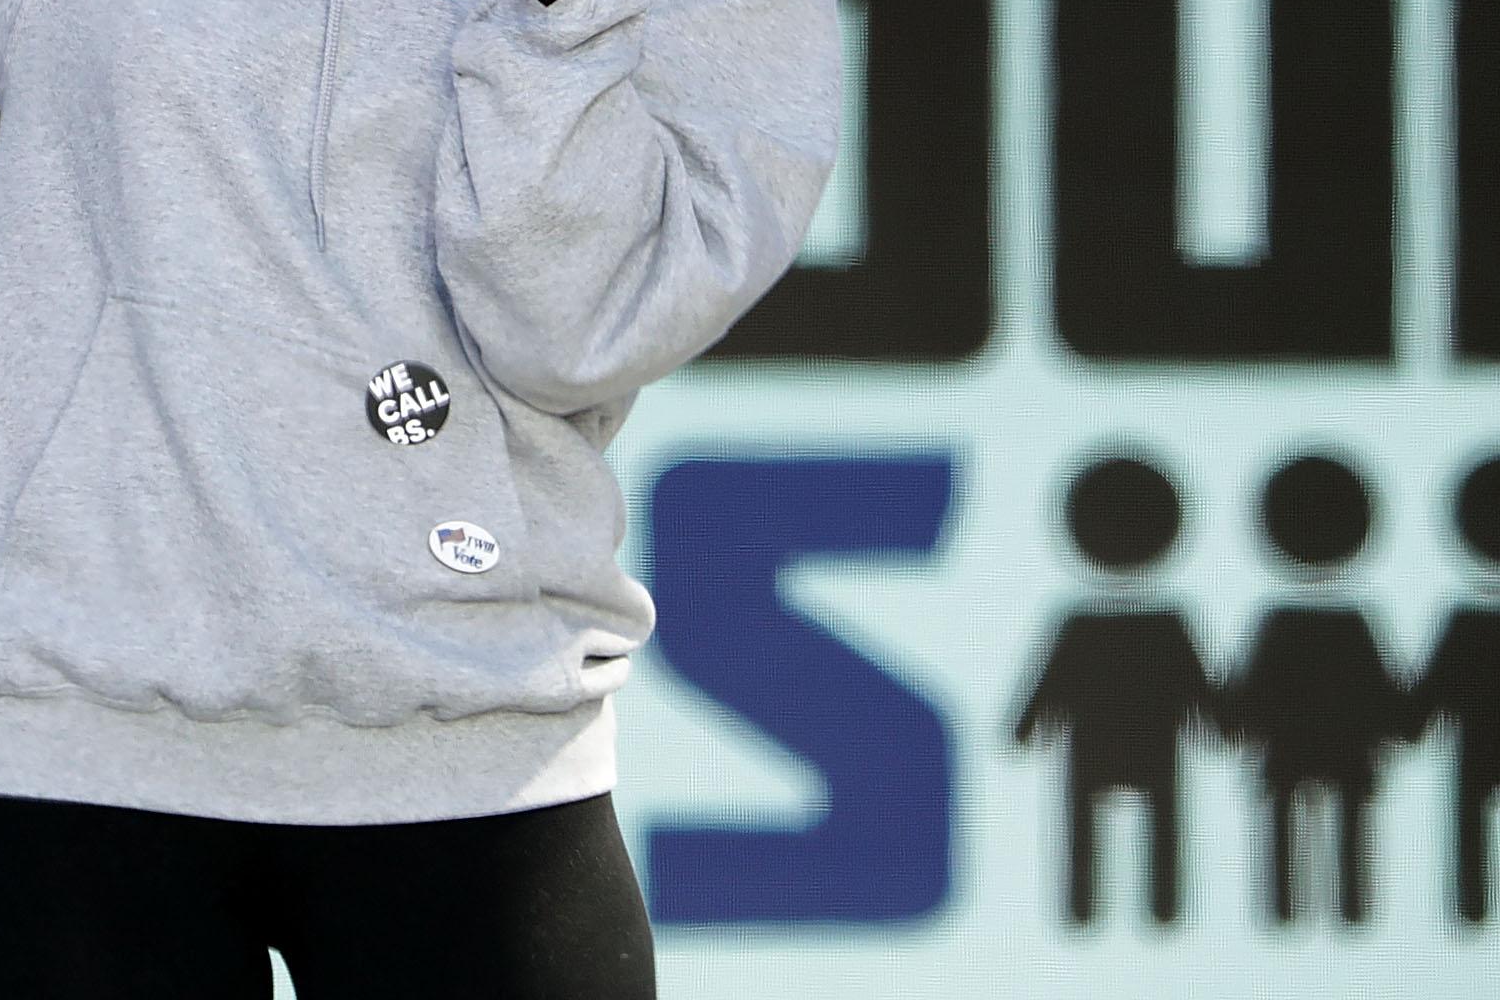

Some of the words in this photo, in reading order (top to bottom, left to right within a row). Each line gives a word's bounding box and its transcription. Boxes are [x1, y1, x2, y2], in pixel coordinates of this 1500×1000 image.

[368, 362, 413, 400] WE
[377, 380, 451, 424] CALL
[386, 418, 436, 446] BS.
[453, 545, 484, 570] Vote
